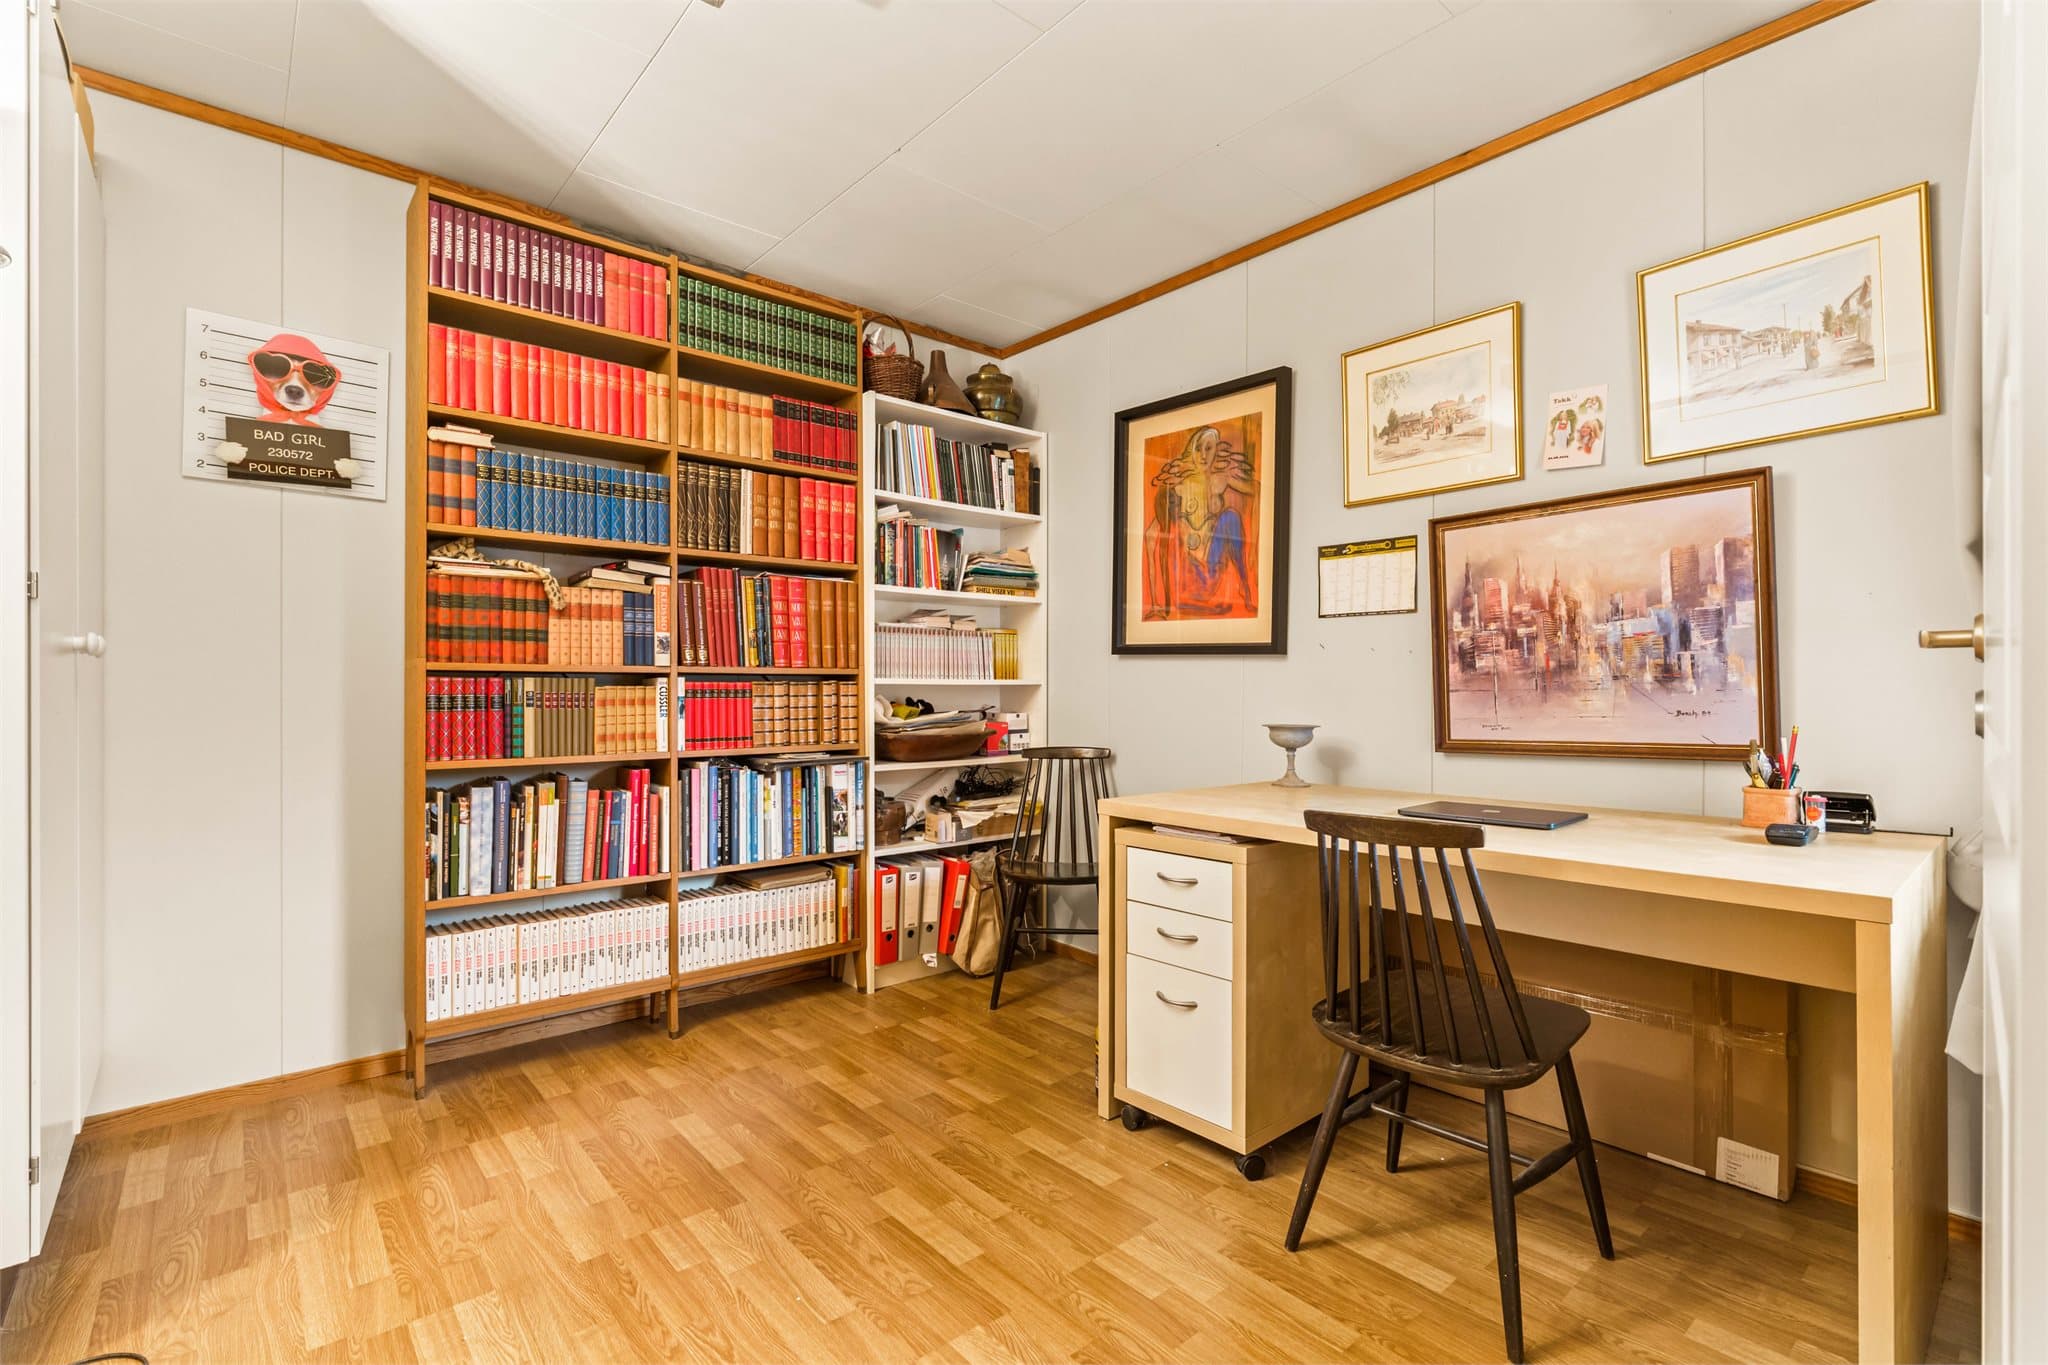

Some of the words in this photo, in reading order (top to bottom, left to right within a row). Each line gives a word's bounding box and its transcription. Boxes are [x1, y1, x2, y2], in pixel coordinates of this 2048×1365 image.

[201, 323, 209, 333] 7
[199, 350, 208, 360] 6
[199, 378, 208, 387] 5
[198, 405, 206, 414] 4
[197, 432, 206, 442] 3
[253, 429, 284, 442] BAD
[291, 433, 326, 448] GIRL
[267, 447, 313, 460] 230572
[196, 459, 205, 468] 2
[248, 462, 297, 476] POLICE
[300, 467, 335, 479] DEPT.
[659, 586, 669, 630] SKEDSMO
[659, 686, 668, 718] CUSSLER
